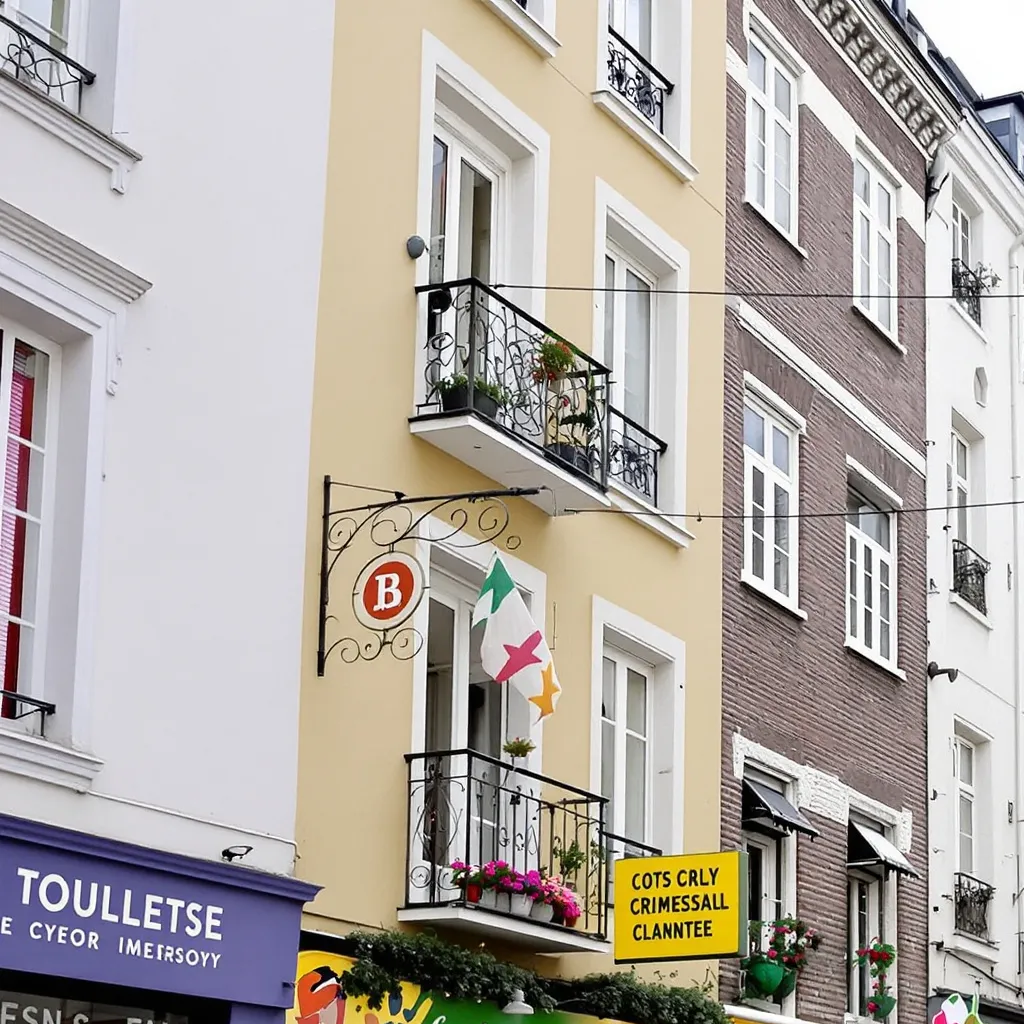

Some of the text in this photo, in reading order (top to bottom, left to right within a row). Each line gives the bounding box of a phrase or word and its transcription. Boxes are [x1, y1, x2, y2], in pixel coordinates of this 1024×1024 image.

[373, 573, 402, 611] B
[631, 871, 671, 890] COTS
[17, 867, 224, 941] TOULLETSE
[630, 893, 729, 915] CRIMESSALL
[29, 921, 99, 950] CYEOR
[633, 920, 713, 941] CLANNTEE
